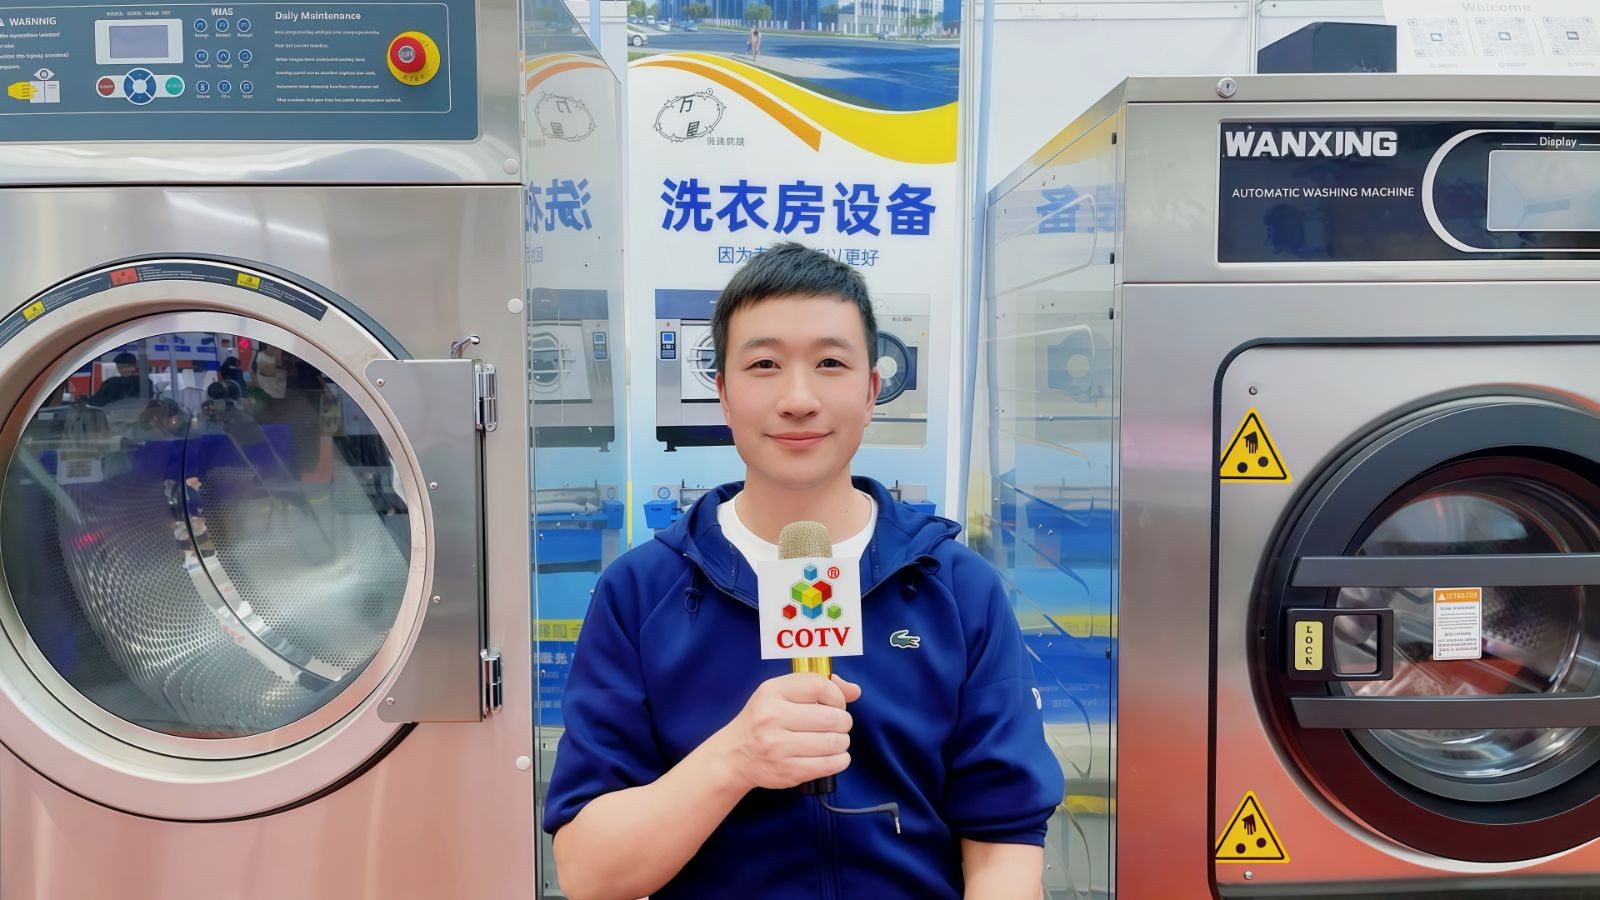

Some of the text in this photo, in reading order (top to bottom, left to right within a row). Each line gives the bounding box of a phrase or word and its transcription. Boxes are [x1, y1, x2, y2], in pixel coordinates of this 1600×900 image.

[275, 11, 361, 22] Daily Maintenance
[1225, 131, 1397, 157] WANXING
[1232, 187, 1415, 198] AUTOMATIC WASHING MACHINE
[660, 178, 936, 237] 洗衣房设备
[776, 627, 851, 649] COTV
[1305, 625, 1313, 666] LOCK
